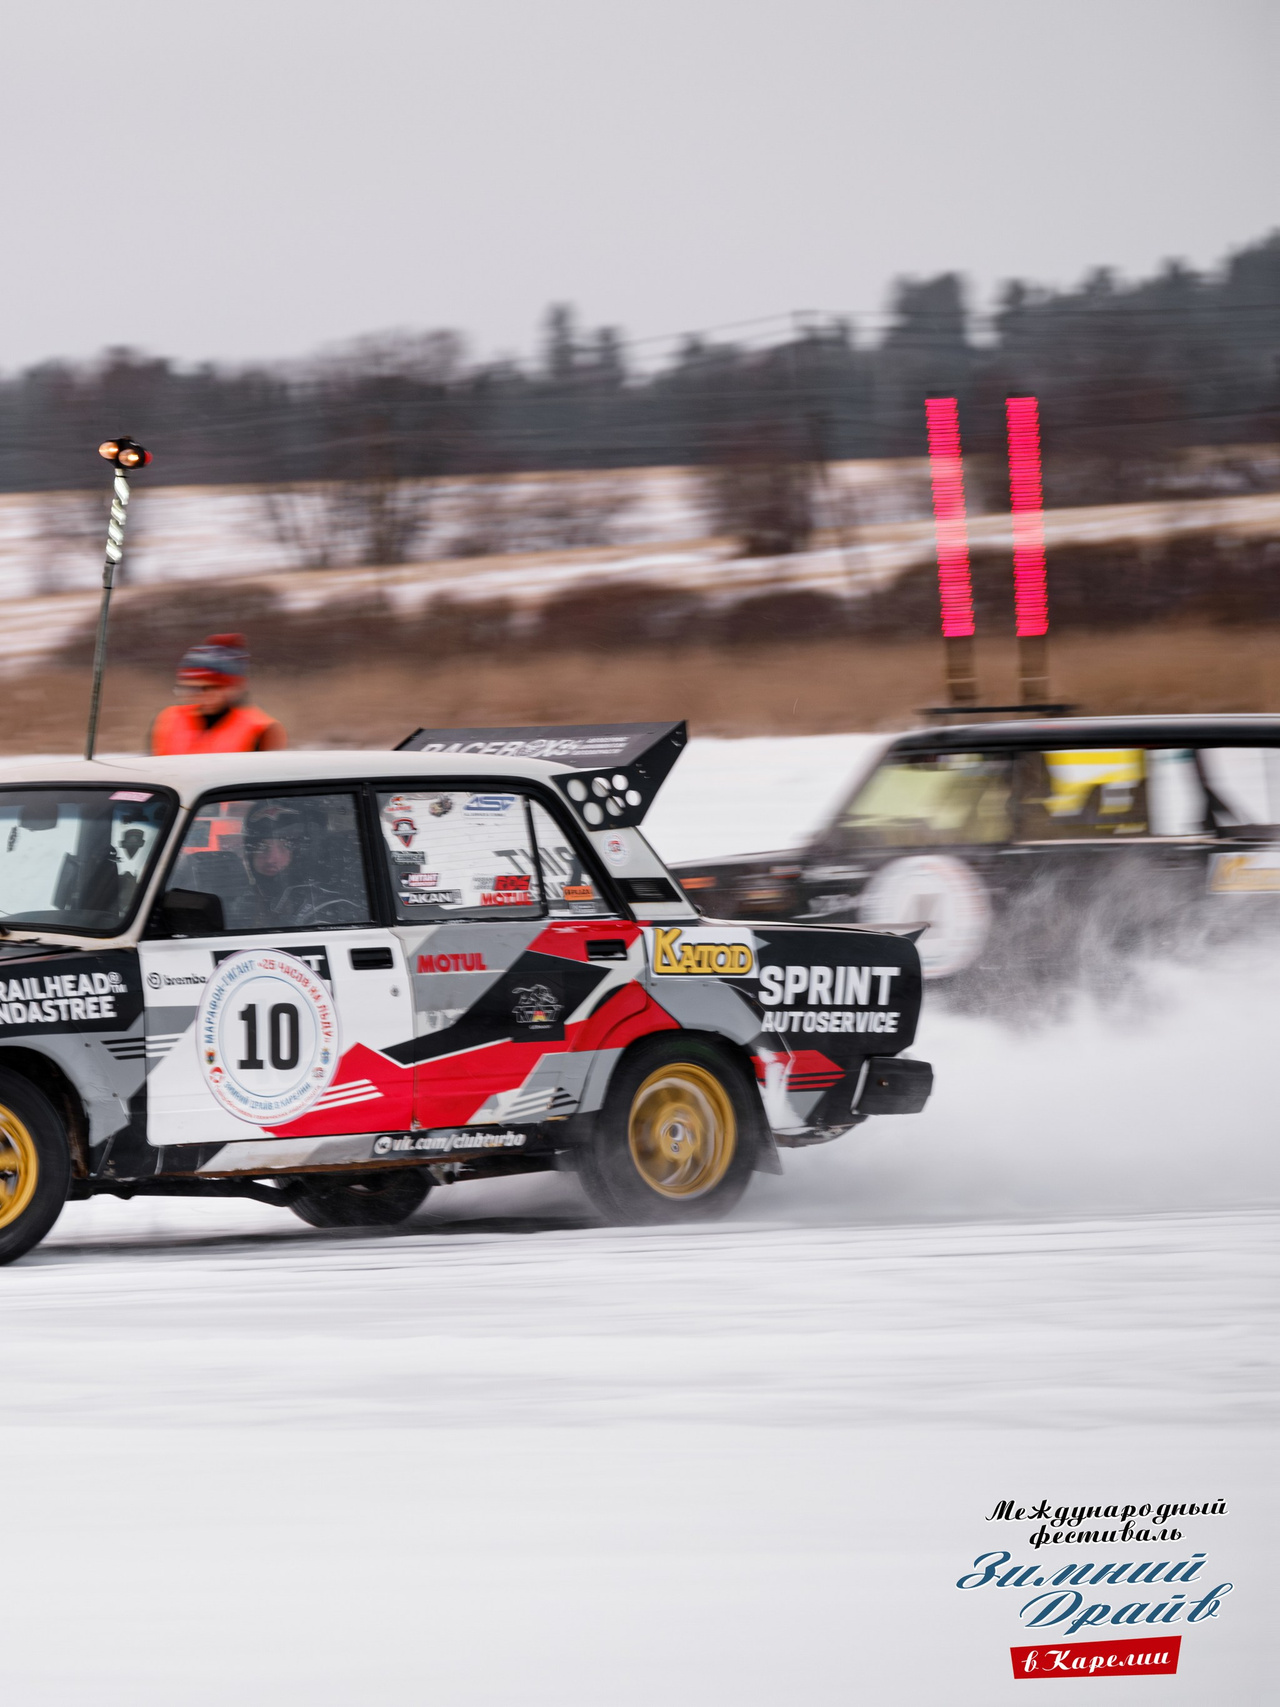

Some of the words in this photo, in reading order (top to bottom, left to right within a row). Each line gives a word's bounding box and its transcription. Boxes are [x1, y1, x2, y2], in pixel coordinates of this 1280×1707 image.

[416, 952, 488, 974] MOTUL
[163, 973, 208, 987] brembo
[277, 961, 311, 989] ЧАСОВ
[758, 965, 902, 1006] SPRINT
[761, 1011, 901, 1033] AUTOSERVICE
[237, 1001, 301, 1072] 10
[392, 1130, 528, 1152] vk.com/clubturbo
